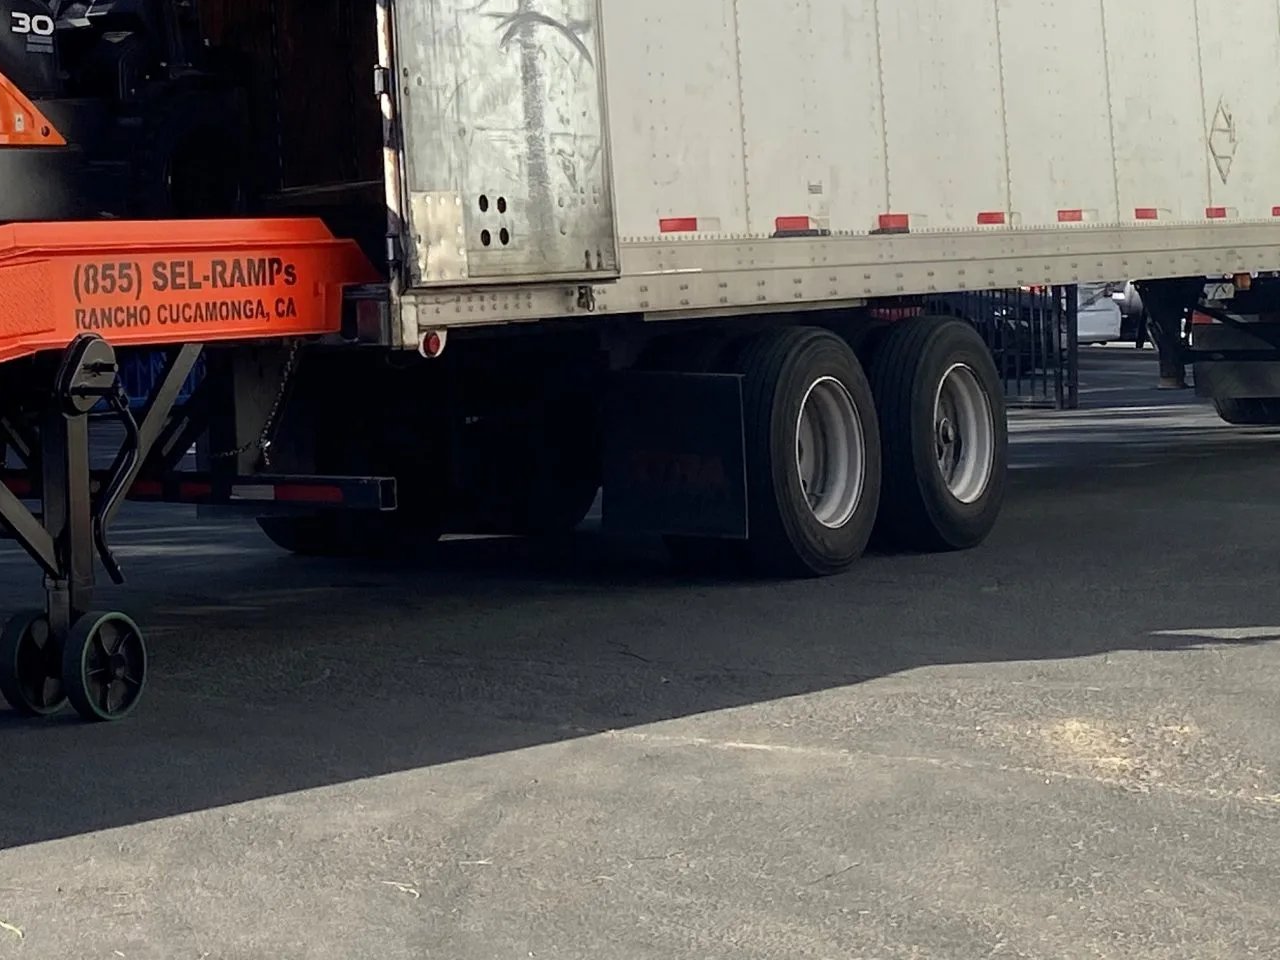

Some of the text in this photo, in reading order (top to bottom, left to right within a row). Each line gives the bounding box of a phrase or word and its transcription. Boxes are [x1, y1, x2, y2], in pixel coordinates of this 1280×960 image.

[11, 11, 55, 36] 30
[73, 262, 142, 303] (855)
[75, 296, 297, 330] RANCHO CUCAMONGA, CA
